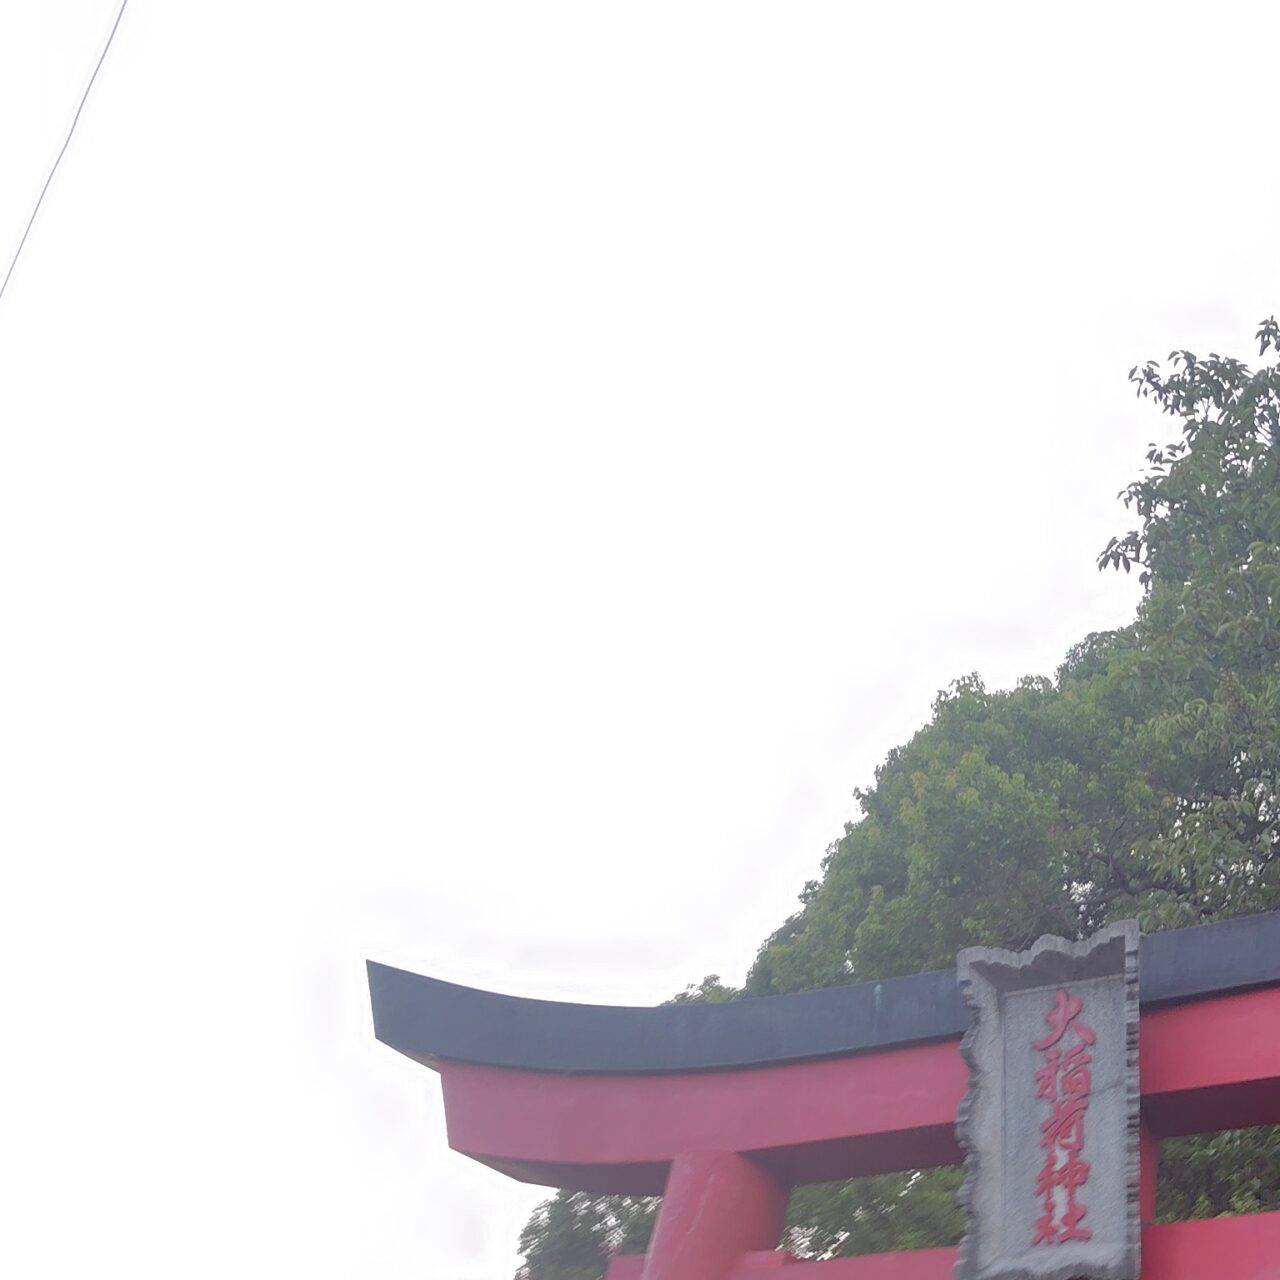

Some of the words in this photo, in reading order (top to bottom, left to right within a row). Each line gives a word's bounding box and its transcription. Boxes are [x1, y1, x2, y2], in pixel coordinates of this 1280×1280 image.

[1031, 987, 1096, 1248] 大稲荷神社
